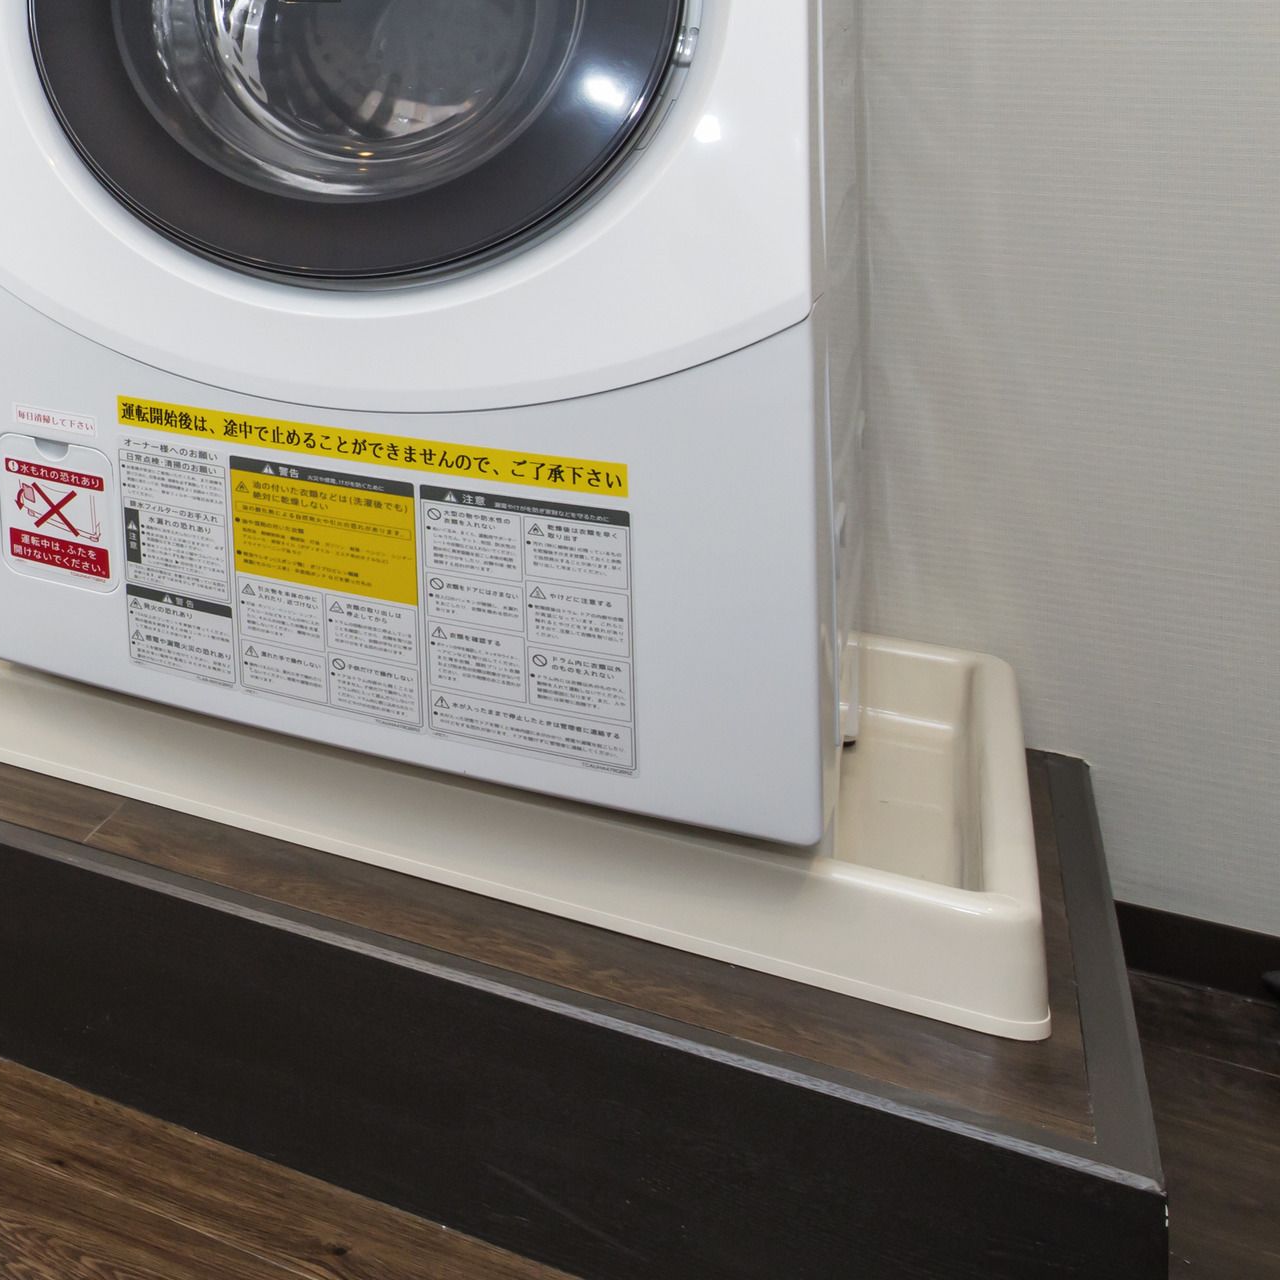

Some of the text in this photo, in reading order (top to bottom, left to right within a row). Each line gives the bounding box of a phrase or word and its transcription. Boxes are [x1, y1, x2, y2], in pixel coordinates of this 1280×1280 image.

[17, 409, 95, 432] 毎日清掃して下さい
[121, 402, 623, 489] 運転開始後は、途中で止めることができませんので、ご了承下さい
[123, 438, 219, 462] オーナー様へのお願い
[19, 463, 101, 489] 水もれの恐れあり
[278, 466, 299, 479] 警告
[462, 493, 486, 507] 注意
[148, 516, 211, 535] 水漏れの恐れあり
[547, 532, 578, 542] 取り出す
[20, 533, 98, 561] 運転中は、ふたを
[13, 543, 108, 576] 開けないでください。
[549, 593, 613, 608] やけどに注意する
